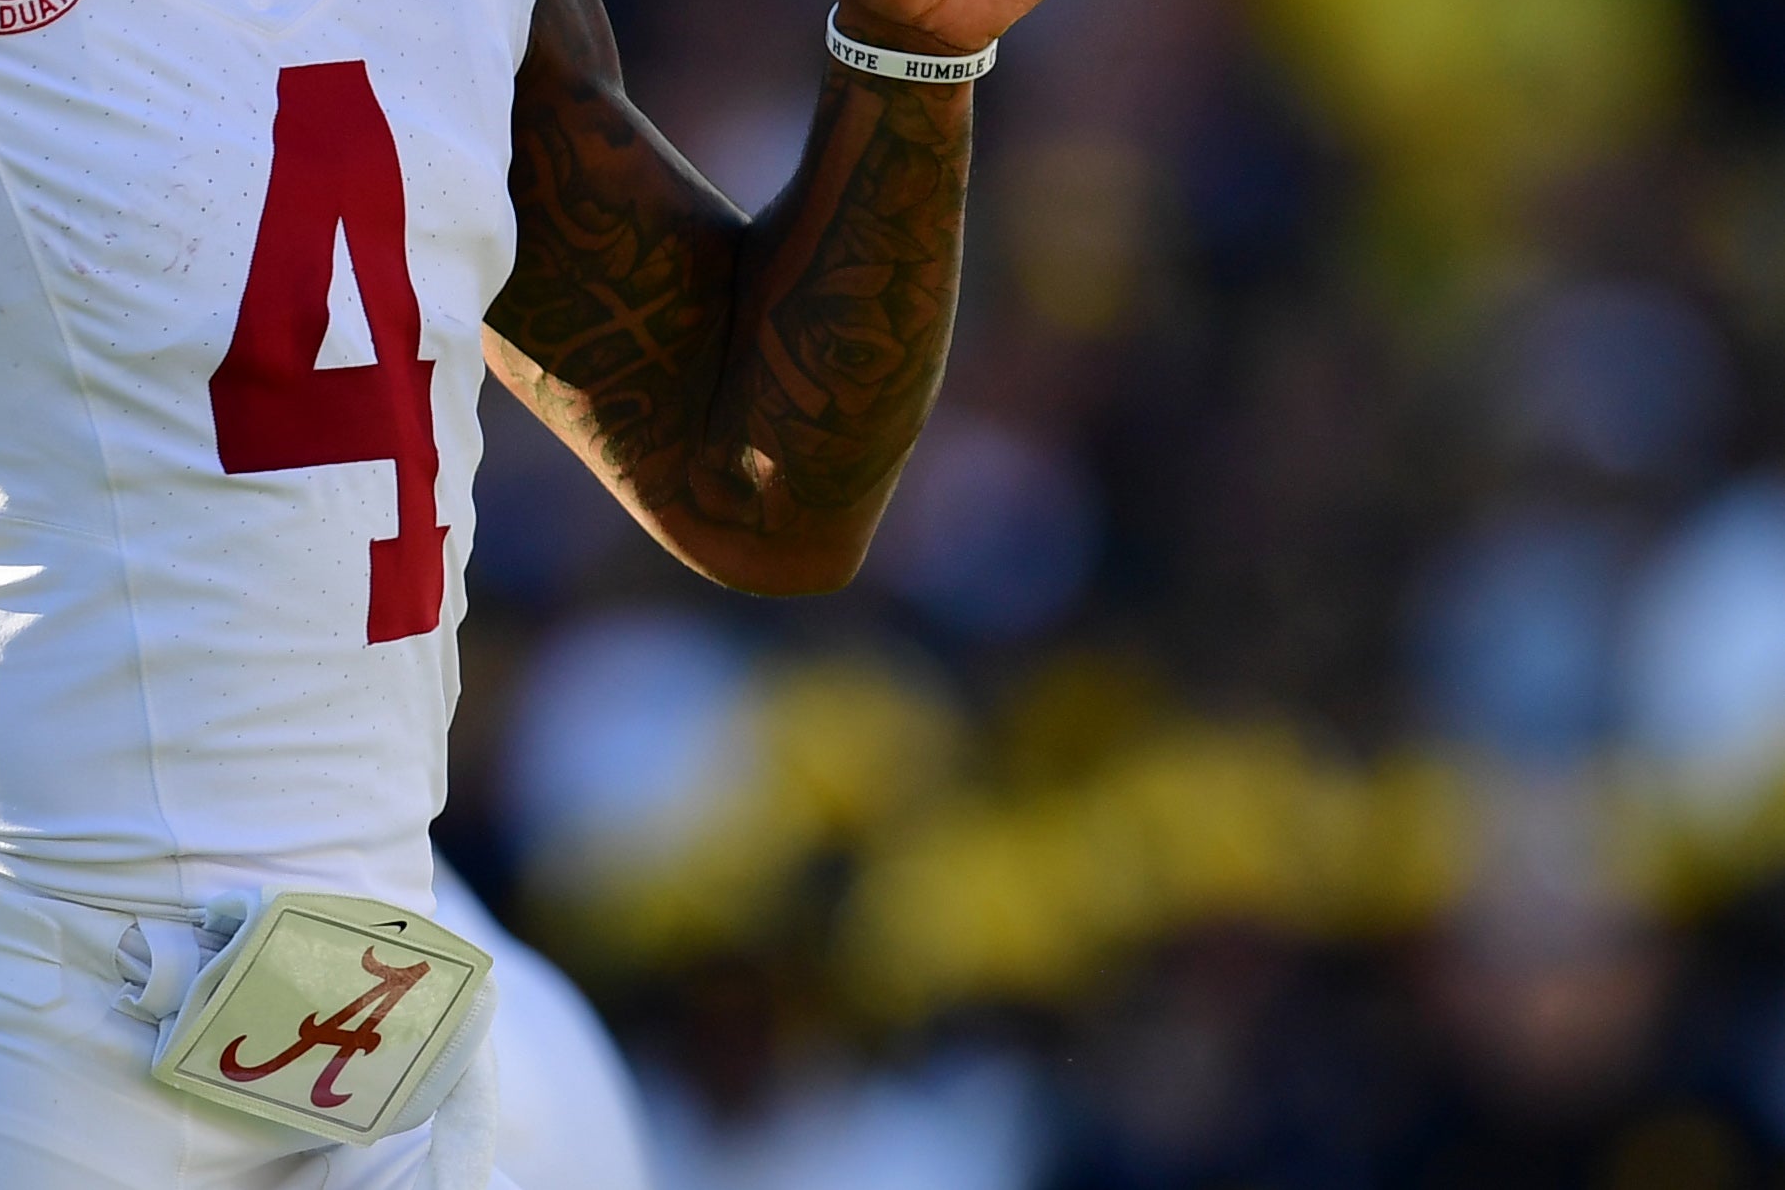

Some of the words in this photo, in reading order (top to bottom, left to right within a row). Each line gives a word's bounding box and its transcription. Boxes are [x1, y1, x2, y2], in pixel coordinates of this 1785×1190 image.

[831, 38, 879, 70] HYPE
[904, 56, 986, 80] HUMBLE
[208, 59, 452, 646] 4
[217, 944, 432, 1110] A
